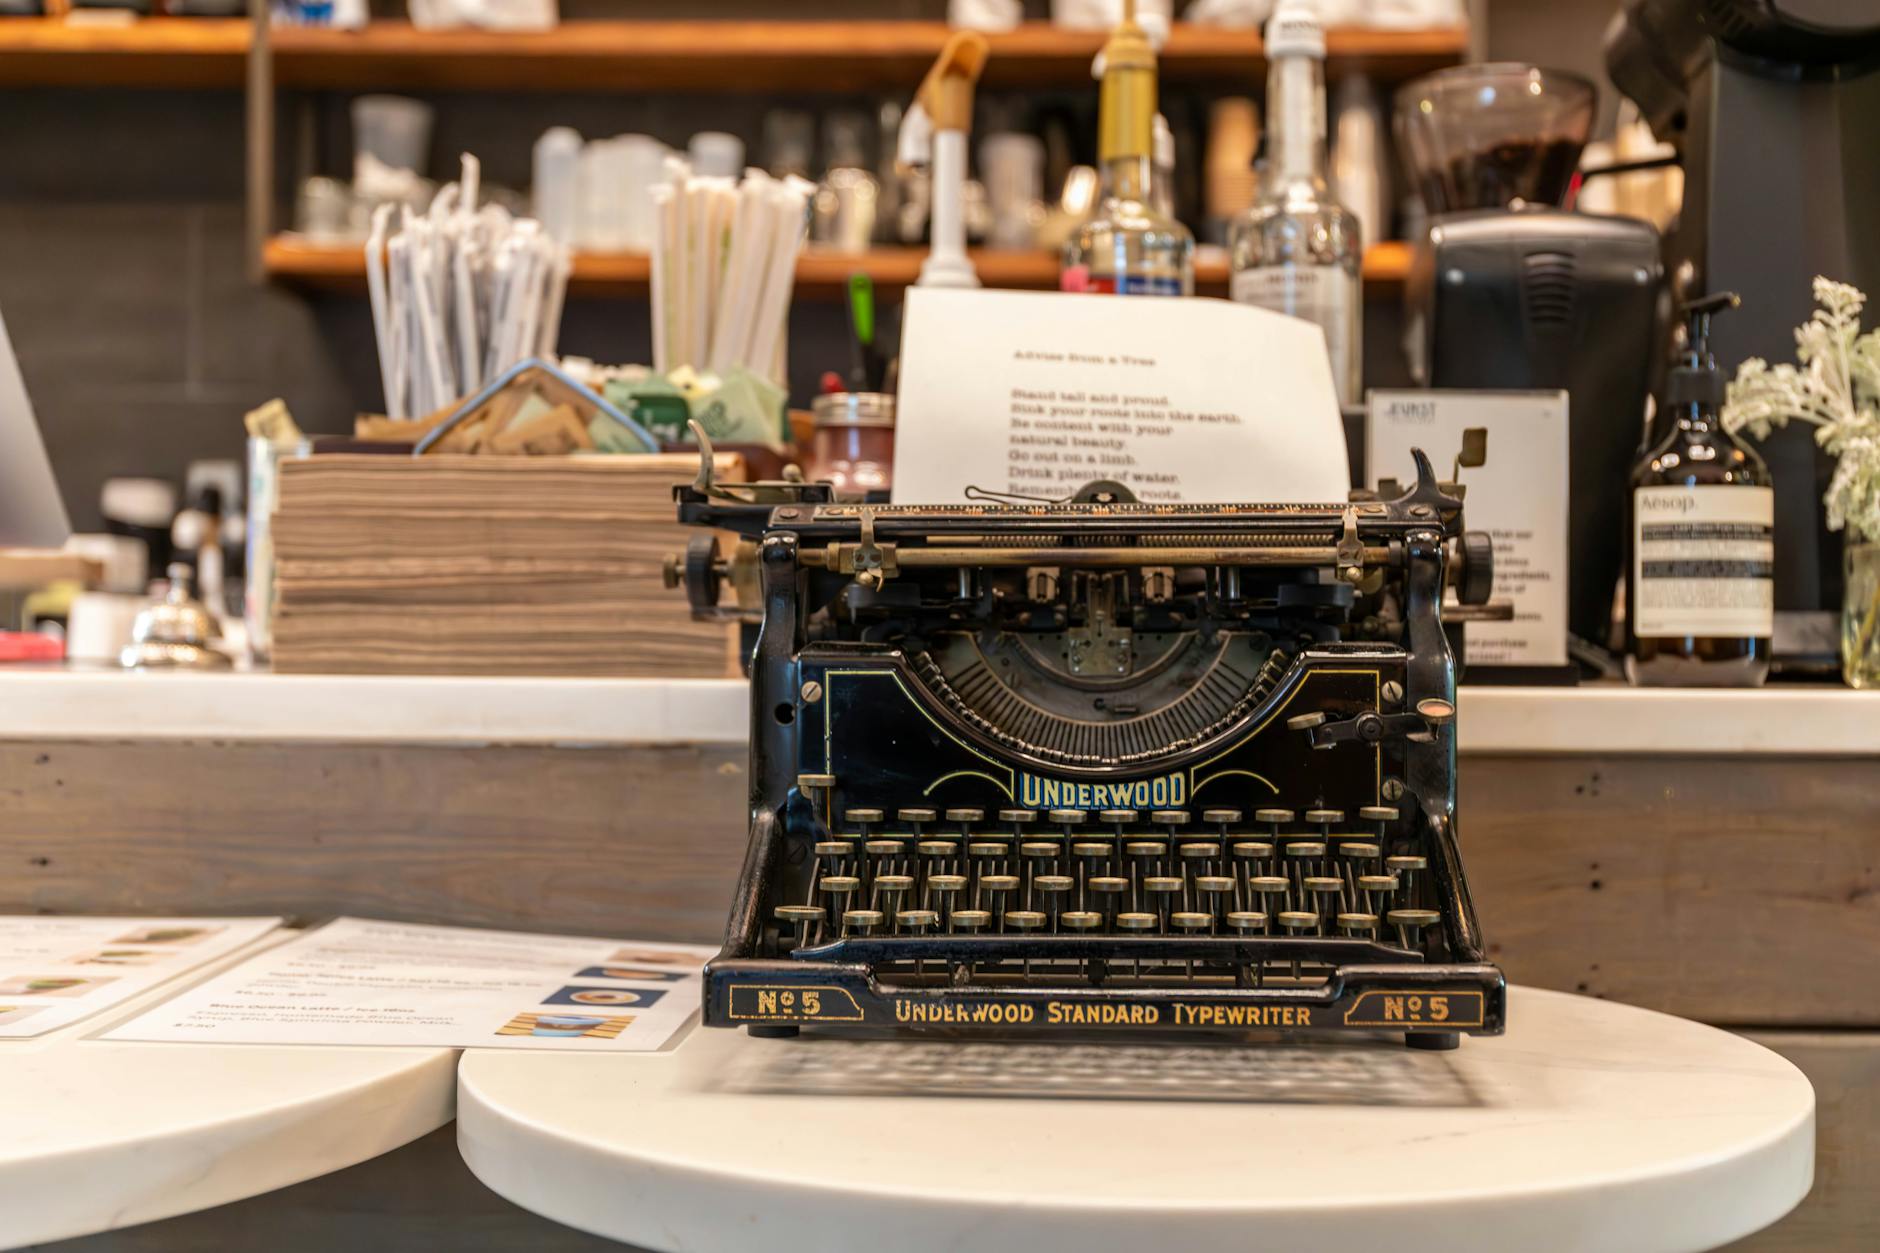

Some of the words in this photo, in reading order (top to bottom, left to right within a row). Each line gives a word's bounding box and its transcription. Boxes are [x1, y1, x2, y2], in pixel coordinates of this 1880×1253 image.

[1010, 388, 1056, 401] Stand
[1060, 391, 1086, 402] tall
[1090, 393, 1119, 404] and
[1010, 403, 1045, 415] Sink
[1050, 406, 1086, 418] your
[1090, 408, 1131, 418] roots
[1134, 408, 1166, 421] into
[1169, 411, 1195, 422] the
[1010, 418, 1030, 430] Be
[1034, 419, 1093, 432] content
[1098, 422, 1132, 434] with
[1136, 425, 1174, 437] your
[1009, 434, 1068, 447] natural
[1009, 450, 1030, 462] Go
[1033, 451, 1059, 463] out
[1063, 454, 1083, 464] on
[1087, 455, 1096, 464] a
[1009, 466, 1053, 479] Drink
[1058, 468, 1108, 481] plenty
[1113, 470, 1130, 482] of
[1133, 473, 1179, 484] water.
[1021, 771, 1186, 808] UNDERWOOD
[896, 1000, 1034, 1022] UNDERWOOD
[1047, 1001, 1159, 1024] STANDARD
[1173, 1003, 1311, 1025] TYPEWRITER
